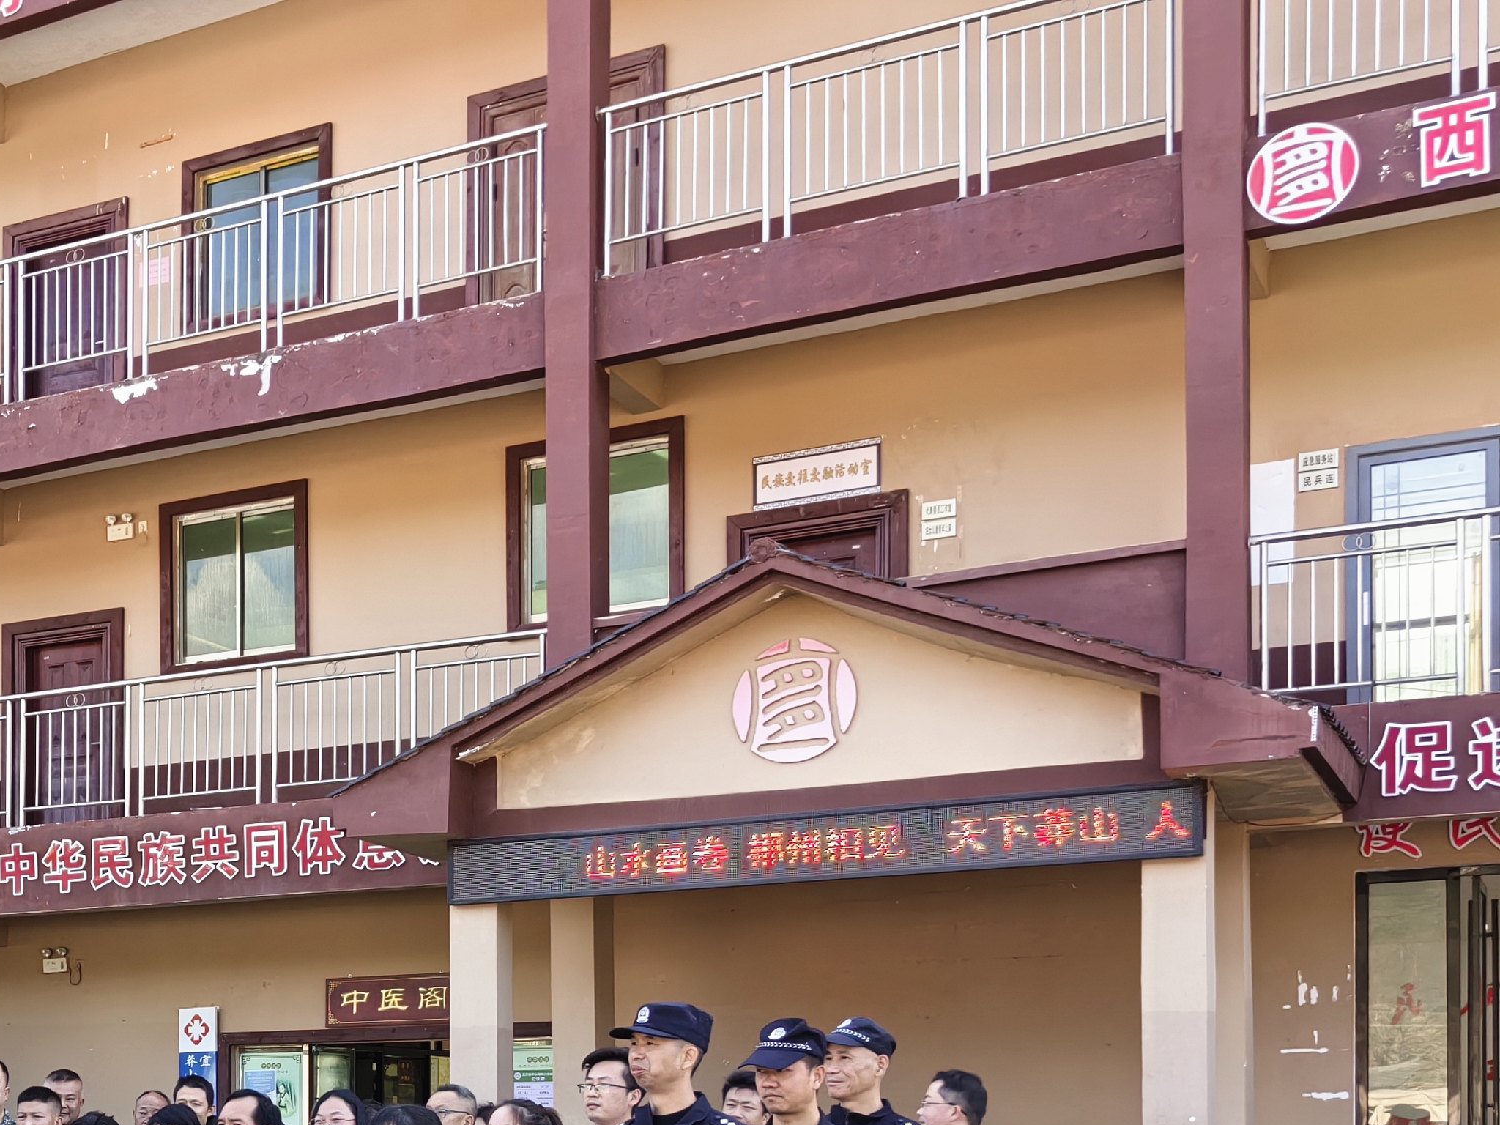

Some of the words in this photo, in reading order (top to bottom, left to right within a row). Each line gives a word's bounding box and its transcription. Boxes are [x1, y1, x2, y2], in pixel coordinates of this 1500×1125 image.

[1412, 91, 1497, 188] 西
[1145, 800, 1192, 839] 人
[340, 986, 447, 1015] 中医阁
